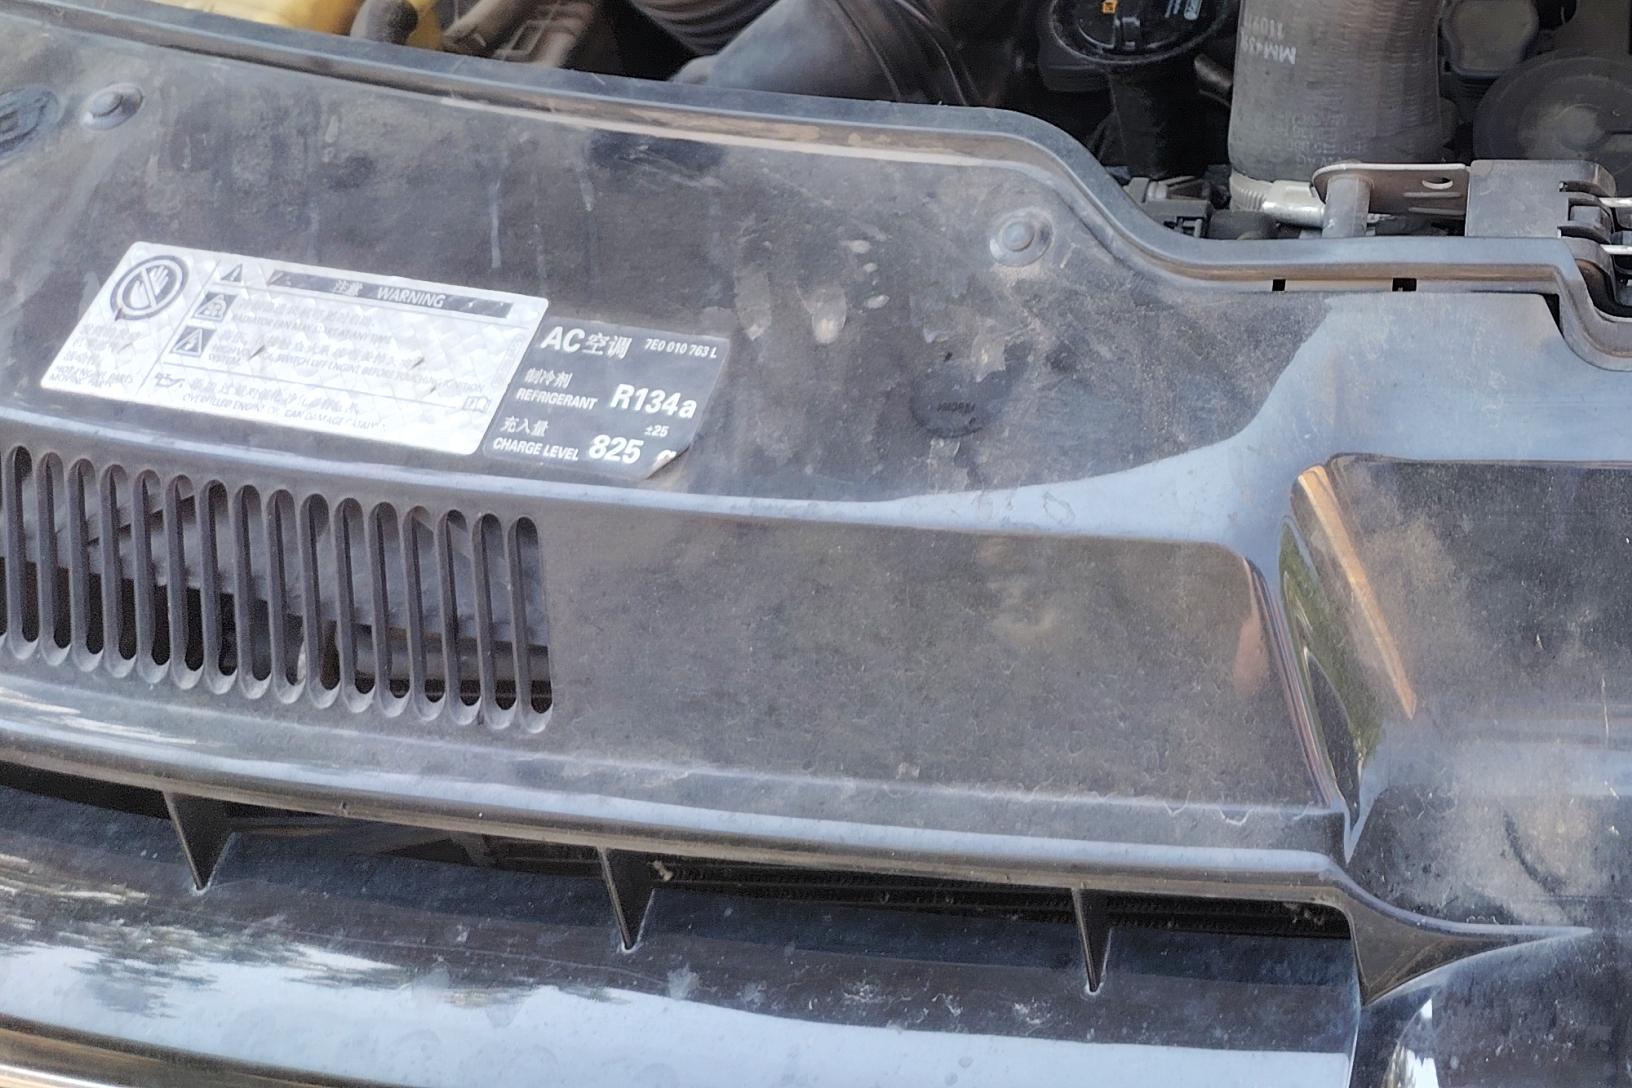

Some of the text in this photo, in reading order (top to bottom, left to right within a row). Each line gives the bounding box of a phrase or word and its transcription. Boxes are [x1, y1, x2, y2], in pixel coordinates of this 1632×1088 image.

[377, 286, 447, 308] WARNING
[644, 338, 717, 358] 7E0 010 763 L
[524, 368, 573, 389] 制冷剂
[516, 387, 598, 410] REFRIGERANT
[610, 383, 697, 418] R134a
[500, 415, 549, 437] 充入量
[493, 437, 579, 461] CHARGE LEVEL
[588, 434, 644, 464] 825
